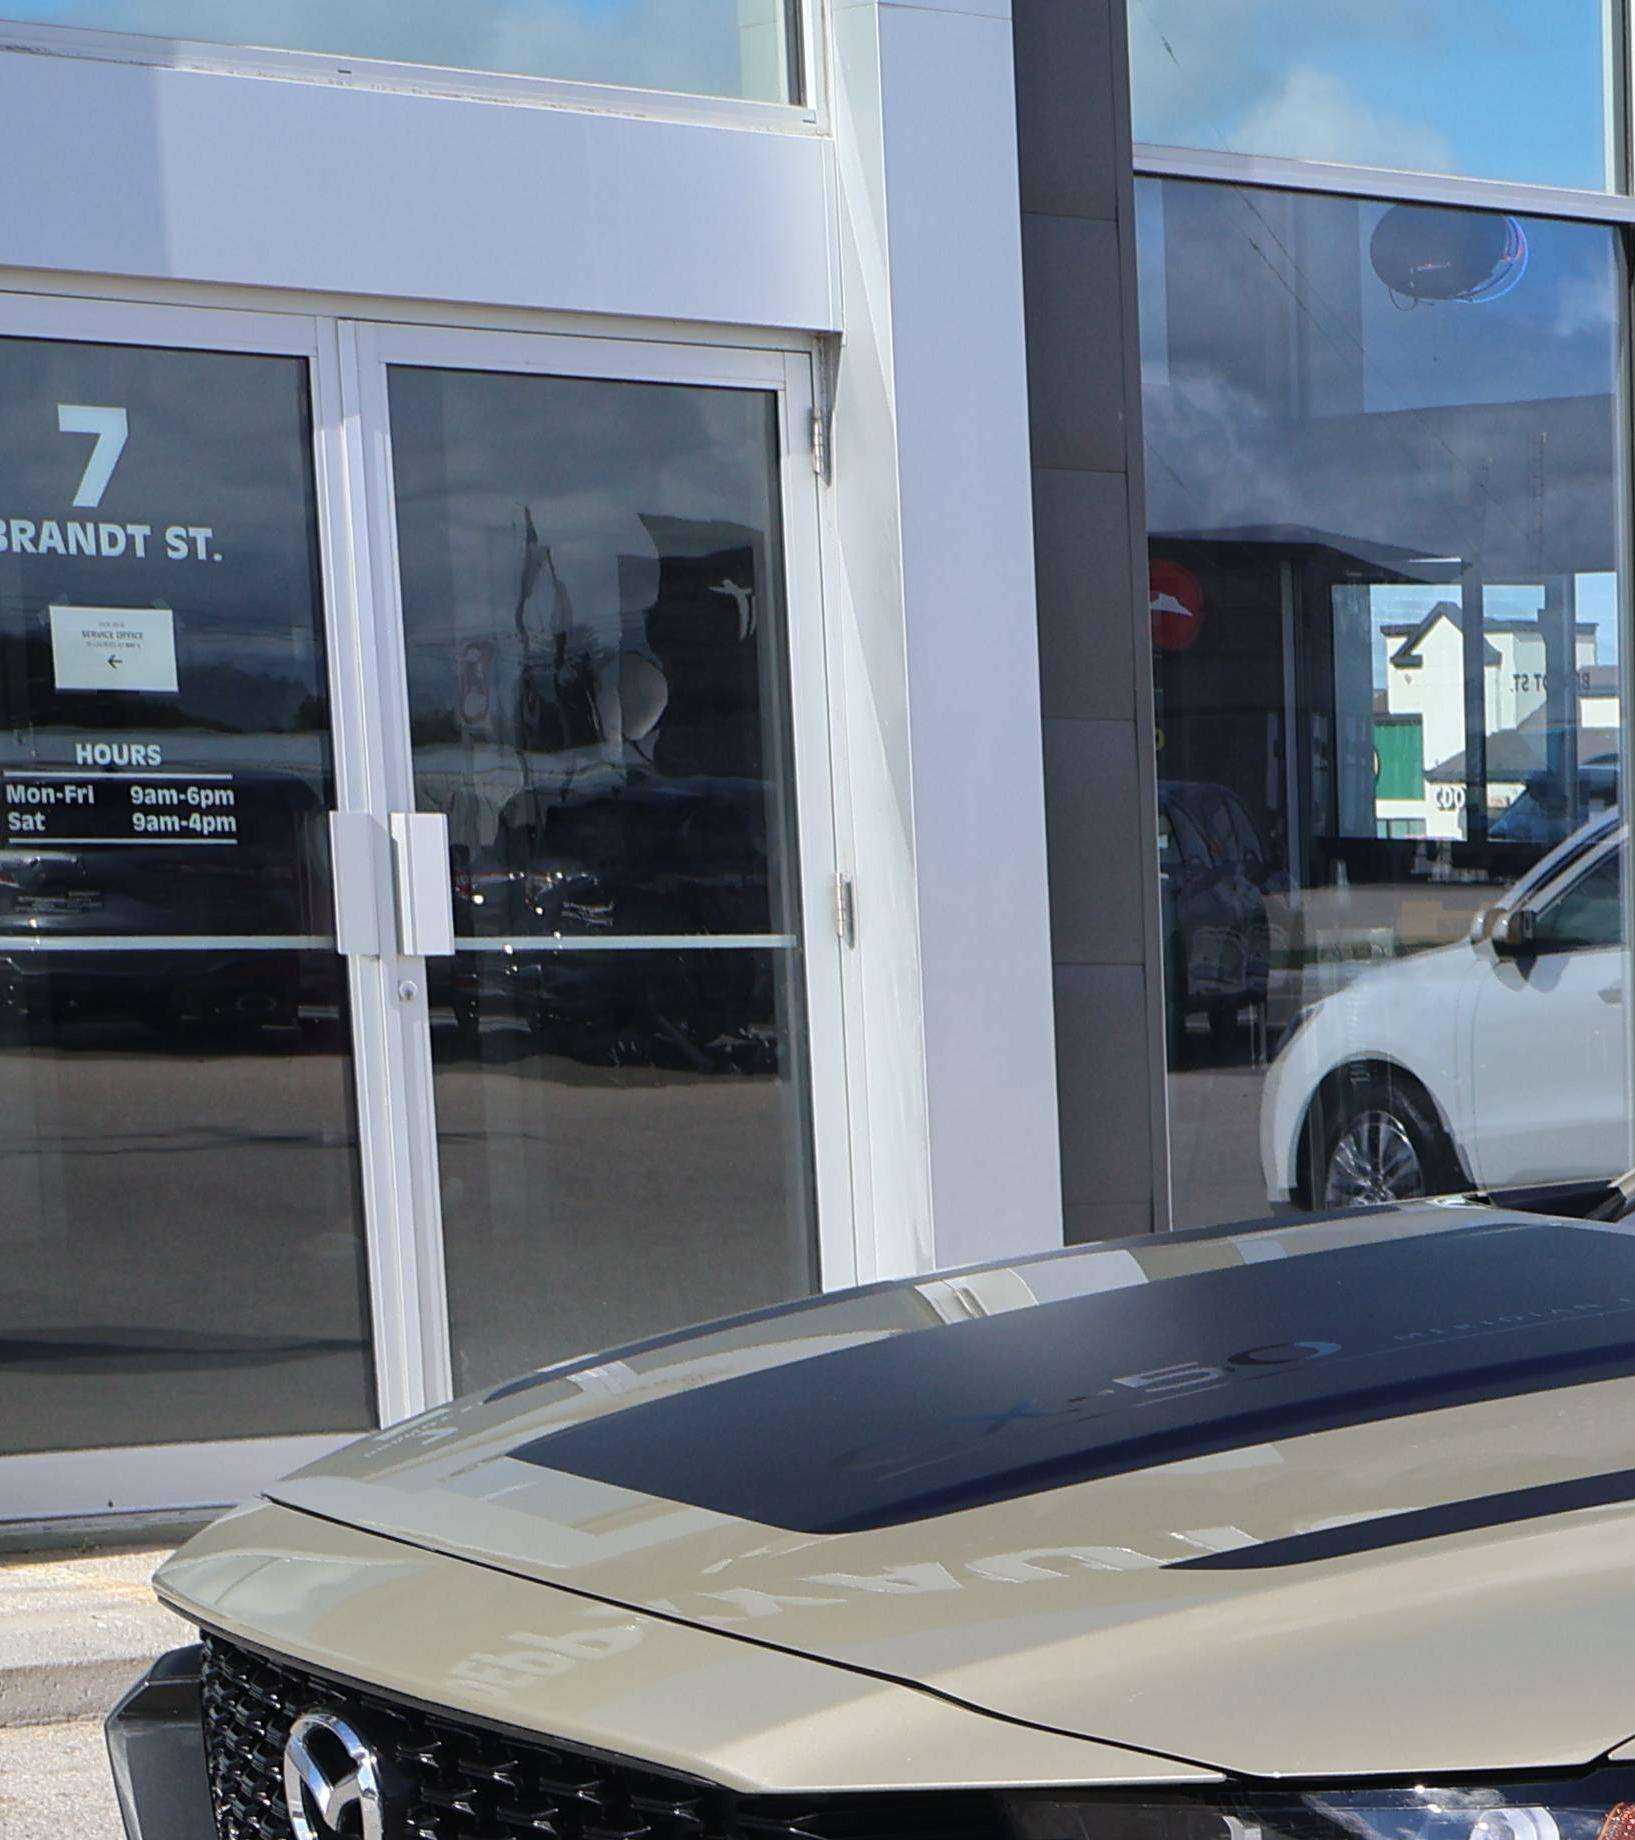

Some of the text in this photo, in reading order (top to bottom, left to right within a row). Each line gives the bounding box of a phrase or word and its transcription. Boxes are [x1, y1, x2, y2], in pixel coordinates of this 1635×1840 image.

[57, 403, 129, 508] 7
[165, 525, 223, 562] ST.
[75, 743, 162, 766] HOURS
[6, 784, 235, 809] Mon-Fri 9am-6pm
[8, 811, 238, 836] Sat 9am-4pm
